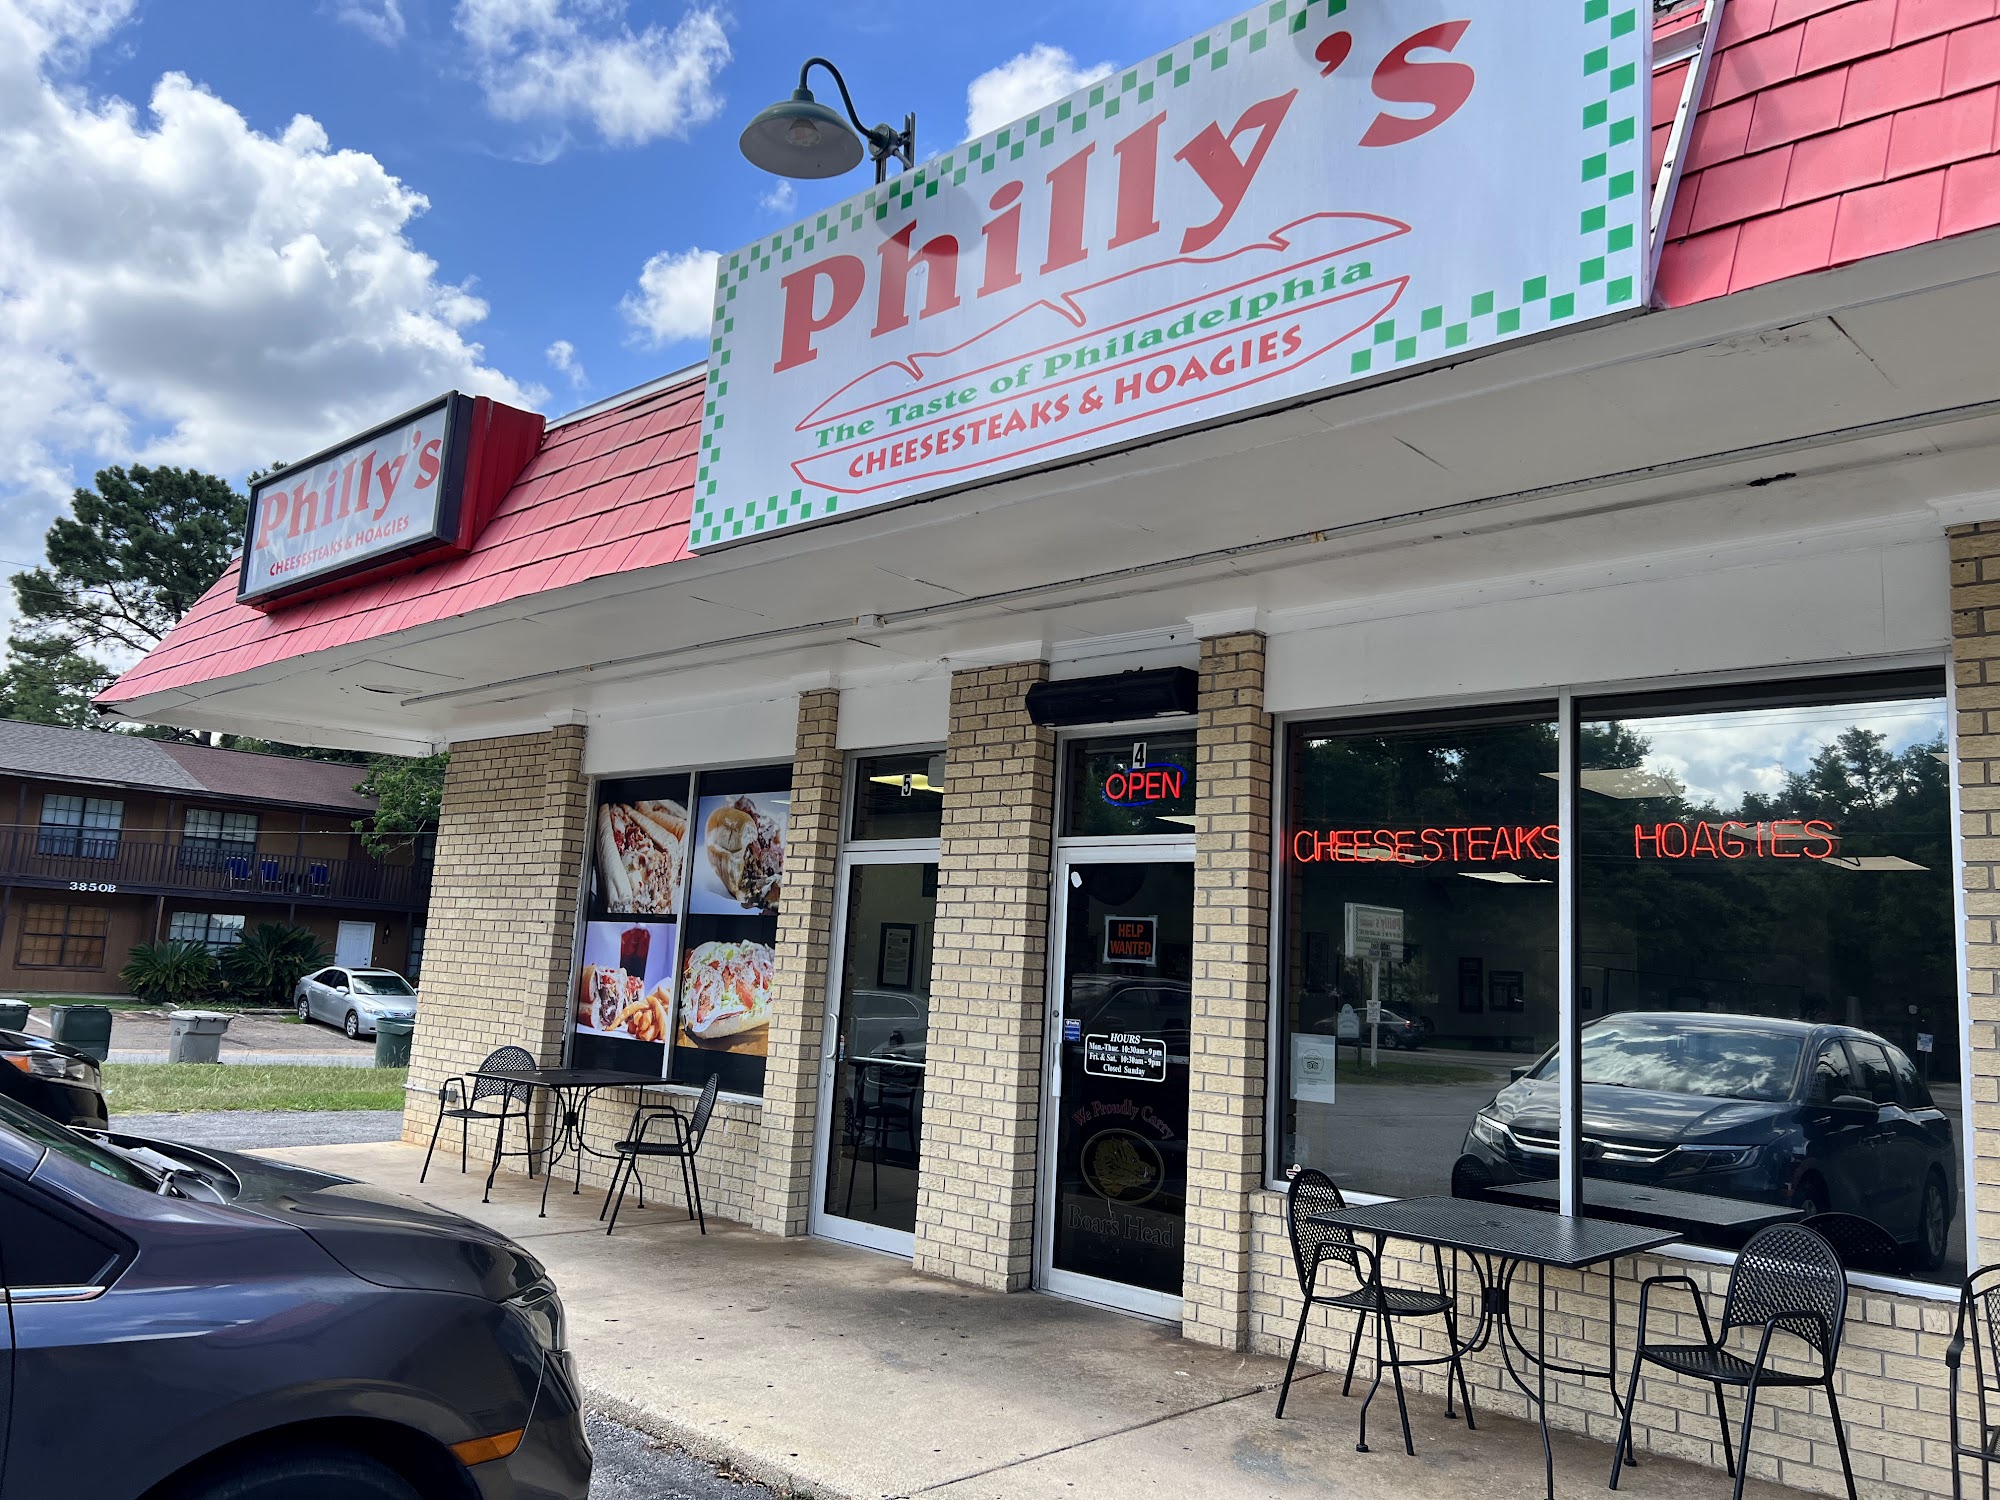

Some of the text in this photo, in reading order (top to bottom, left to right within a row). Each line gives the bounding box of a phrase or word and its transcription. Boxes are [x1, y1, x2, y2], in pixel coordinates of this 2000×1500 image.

[774, 20, 1475, 373] Philly's
[816, 260, 1373, 449] The Taste of Philadelphia
[848, 324, 1303, 478] CHEESESTEAKS & HOAGIES
[255, 430, 442, 551] Philly's
[269, 514, 409, 577] CHEESESTEAKS & HOAGIES
[1135, 743, 1145, 768] 4
[903, 774, 911, 796] 5
[1105, 771, 1181, 800] OPEN
[1294, 825, 1559, 863] CHEESESTEAKS
[1634, 820, 1833, 859] HOAGIES
[69, 881, 117, 893] 3850B
[1118, 923, 1144, 938] HELP
[1110, 940, 1151, 956] WANTED
[1110, 1033, 1141, 1044] HOURS
[1089, 1052, 1099, 1061] Fri.
[1100, 1053, 1105, 1061] &
[1106, 1054, 1117, 1063] Sat.
[1103, 1063, 1145, 1077] Closed Sunday
[1072, 1098, 1175, 1140] We Proudly Carry
[1068, 1203, 1174, 1249] Boar's Head
